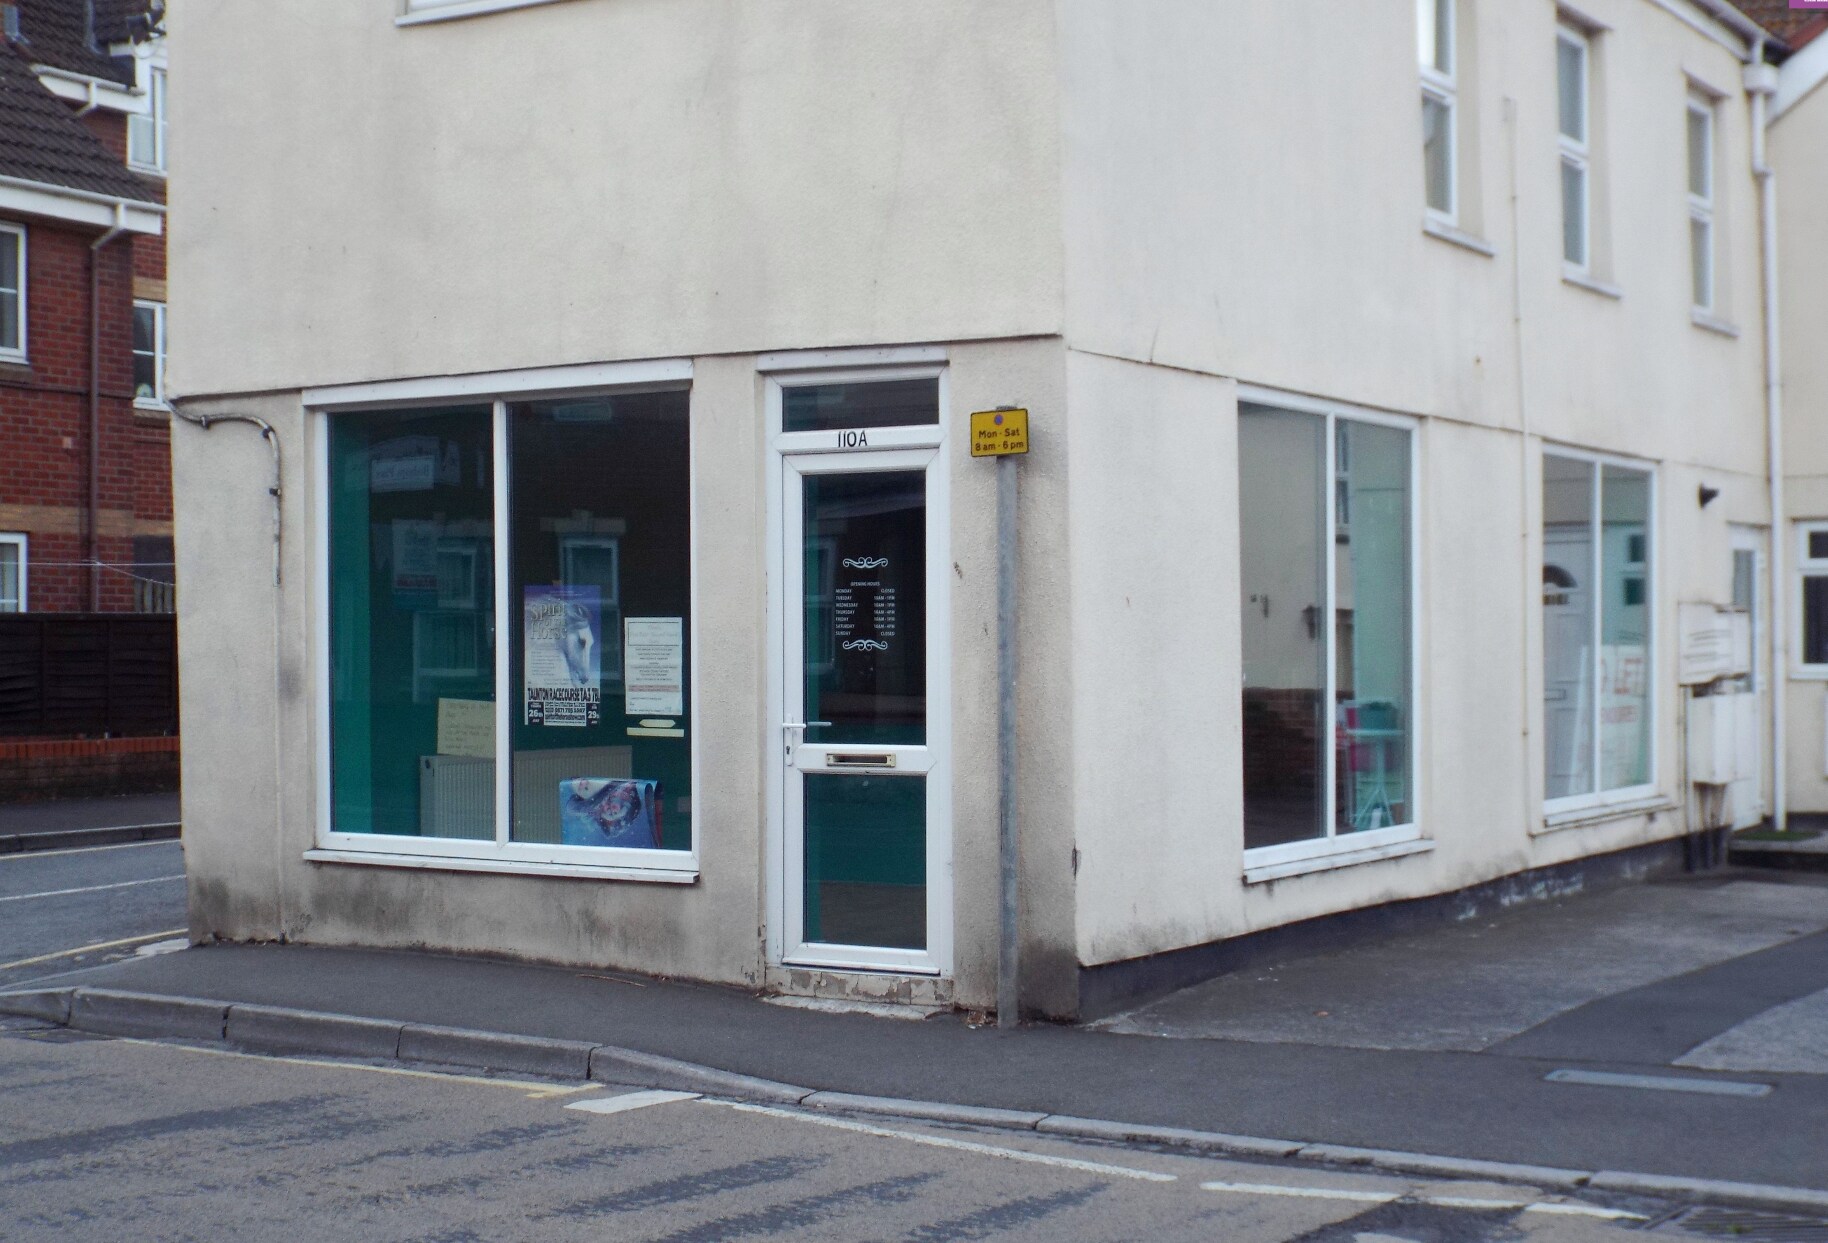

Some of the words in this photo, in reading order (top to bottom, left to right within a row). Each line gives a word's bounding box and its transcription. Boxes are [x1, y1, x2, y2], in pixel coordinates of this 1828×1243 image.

[838, 430, 868, 448] 110A
[978, 430, 998, 439] Mon
[1004, 427, 1020, 437] Sat
[975, 442, 981, 451] 8
[983, 443, 996, 451] am
[1003, 440, 1009, 449] 6
[1010, 441, 1024, 450] pm
[528, 687, 549, 701] TAUNTON
[549, 687, 580, 702] RACECOURSE
